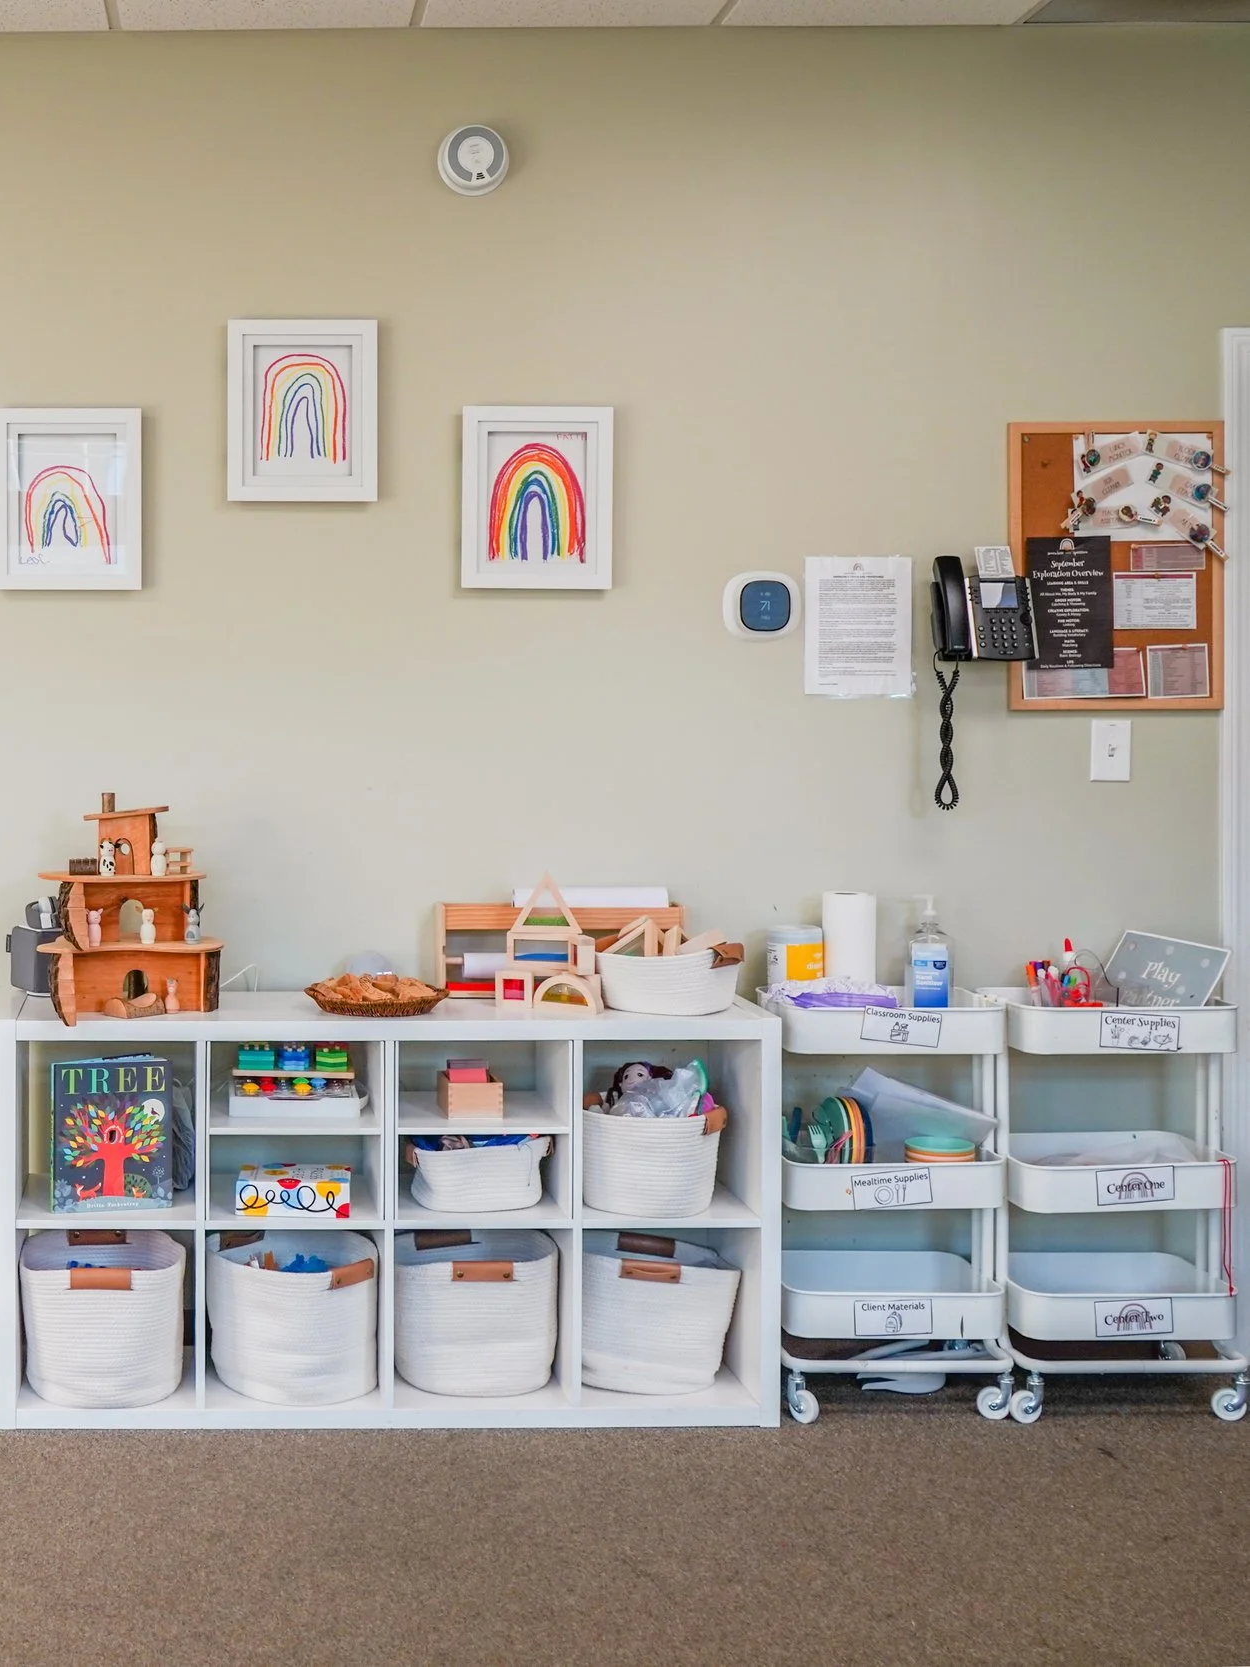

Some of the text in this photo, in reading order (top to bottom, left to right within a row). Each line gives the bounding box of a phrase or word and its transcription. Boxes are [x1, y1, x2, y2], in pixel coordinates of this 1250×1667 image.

[1051, 558, 1085, 570] September
[1032, 569, 1104, 580] Exploration Overview
[760, 600, 770, 611] 71
[1140, 960, 1182, 991] Play
[866, 1008, 940, 1024] Classroom Supplies
[1104, 1016, 1176, 1030] Center Supplies
[61, 1066, 166, 1095] TREE
[854, 1173, 928, 1187] Mealtime Supplies
[1107, 1181, 1165, 1194] Center One
[888, 1302, 925, 1311] Materials
[1104, 1311, 1164, 1326] Center Two
